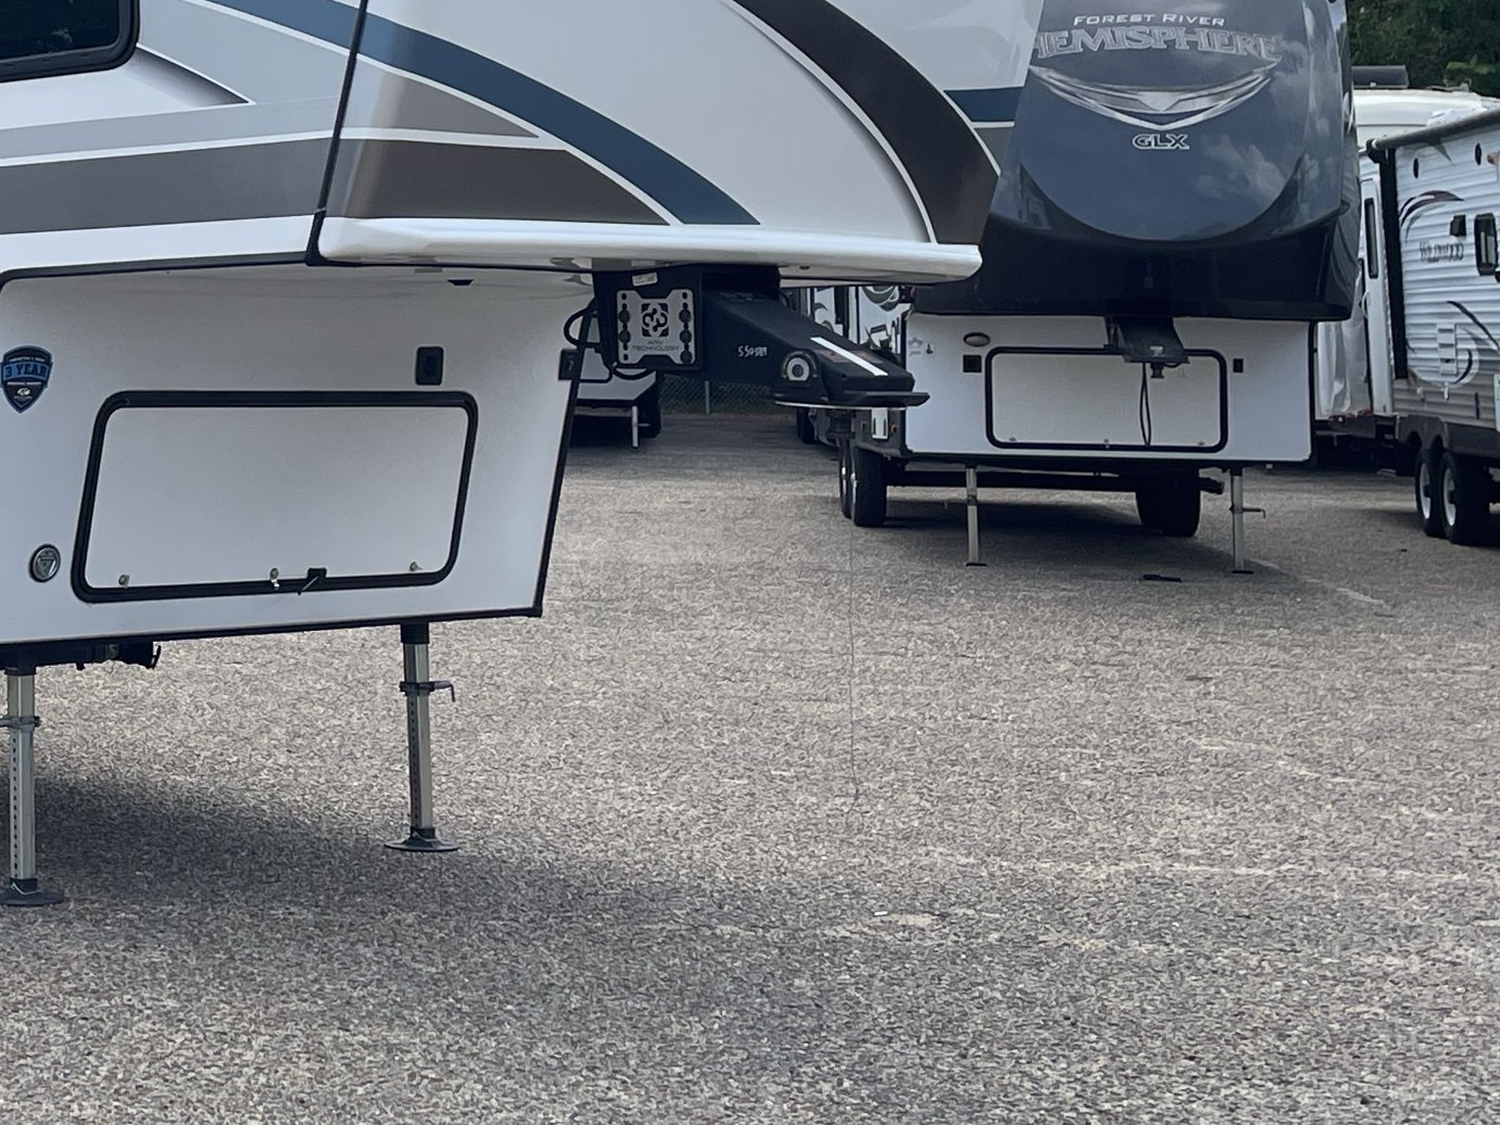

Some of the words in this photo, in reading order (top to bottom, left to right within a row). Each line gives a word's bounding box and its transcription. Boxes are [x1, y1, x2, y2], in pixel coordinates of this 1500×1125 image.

[1074, 13, 1156, 26] FOREST
[1162, 13, 1225, 27] RIVER
[1132, 133, 1190, 150] GLX
[16, 362, 48, 377] YEAR
